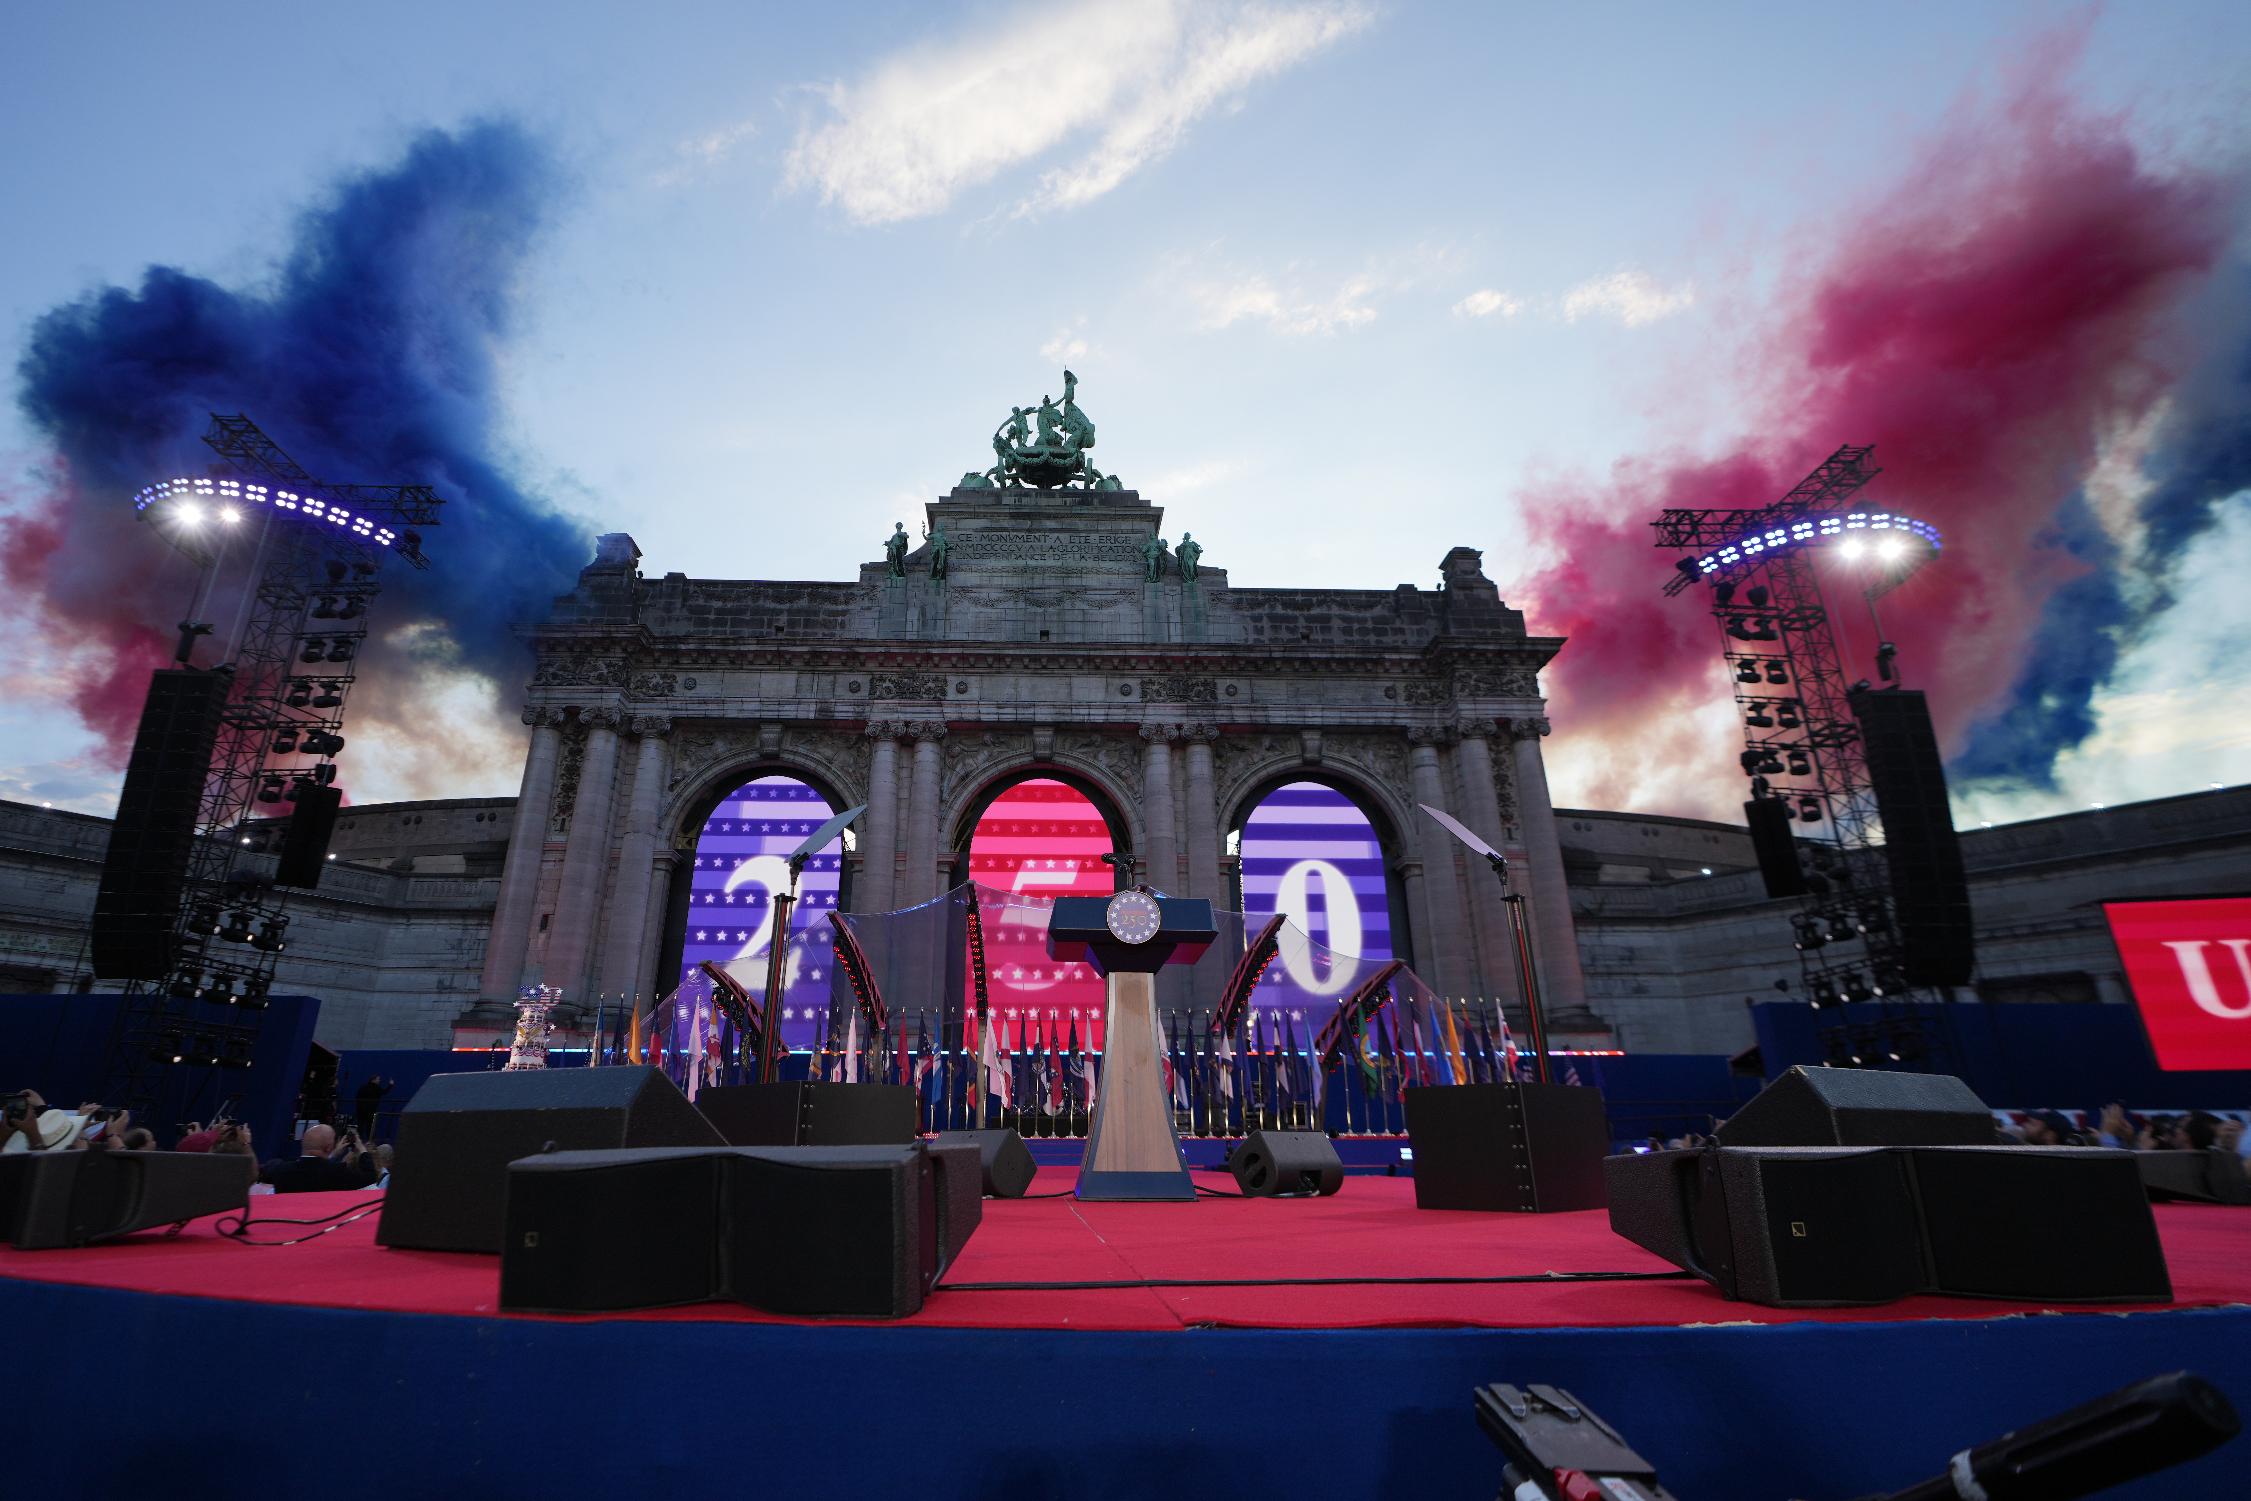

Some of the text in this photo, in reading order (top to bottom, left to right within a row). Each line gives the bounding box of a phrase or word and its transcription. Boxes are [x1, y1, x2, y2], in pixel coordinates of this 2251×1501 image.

[957, 533, 973, 542] CE
[980, 533, 1048, 543] MONVMENT
[1121, 914, 1147, 928] 250
